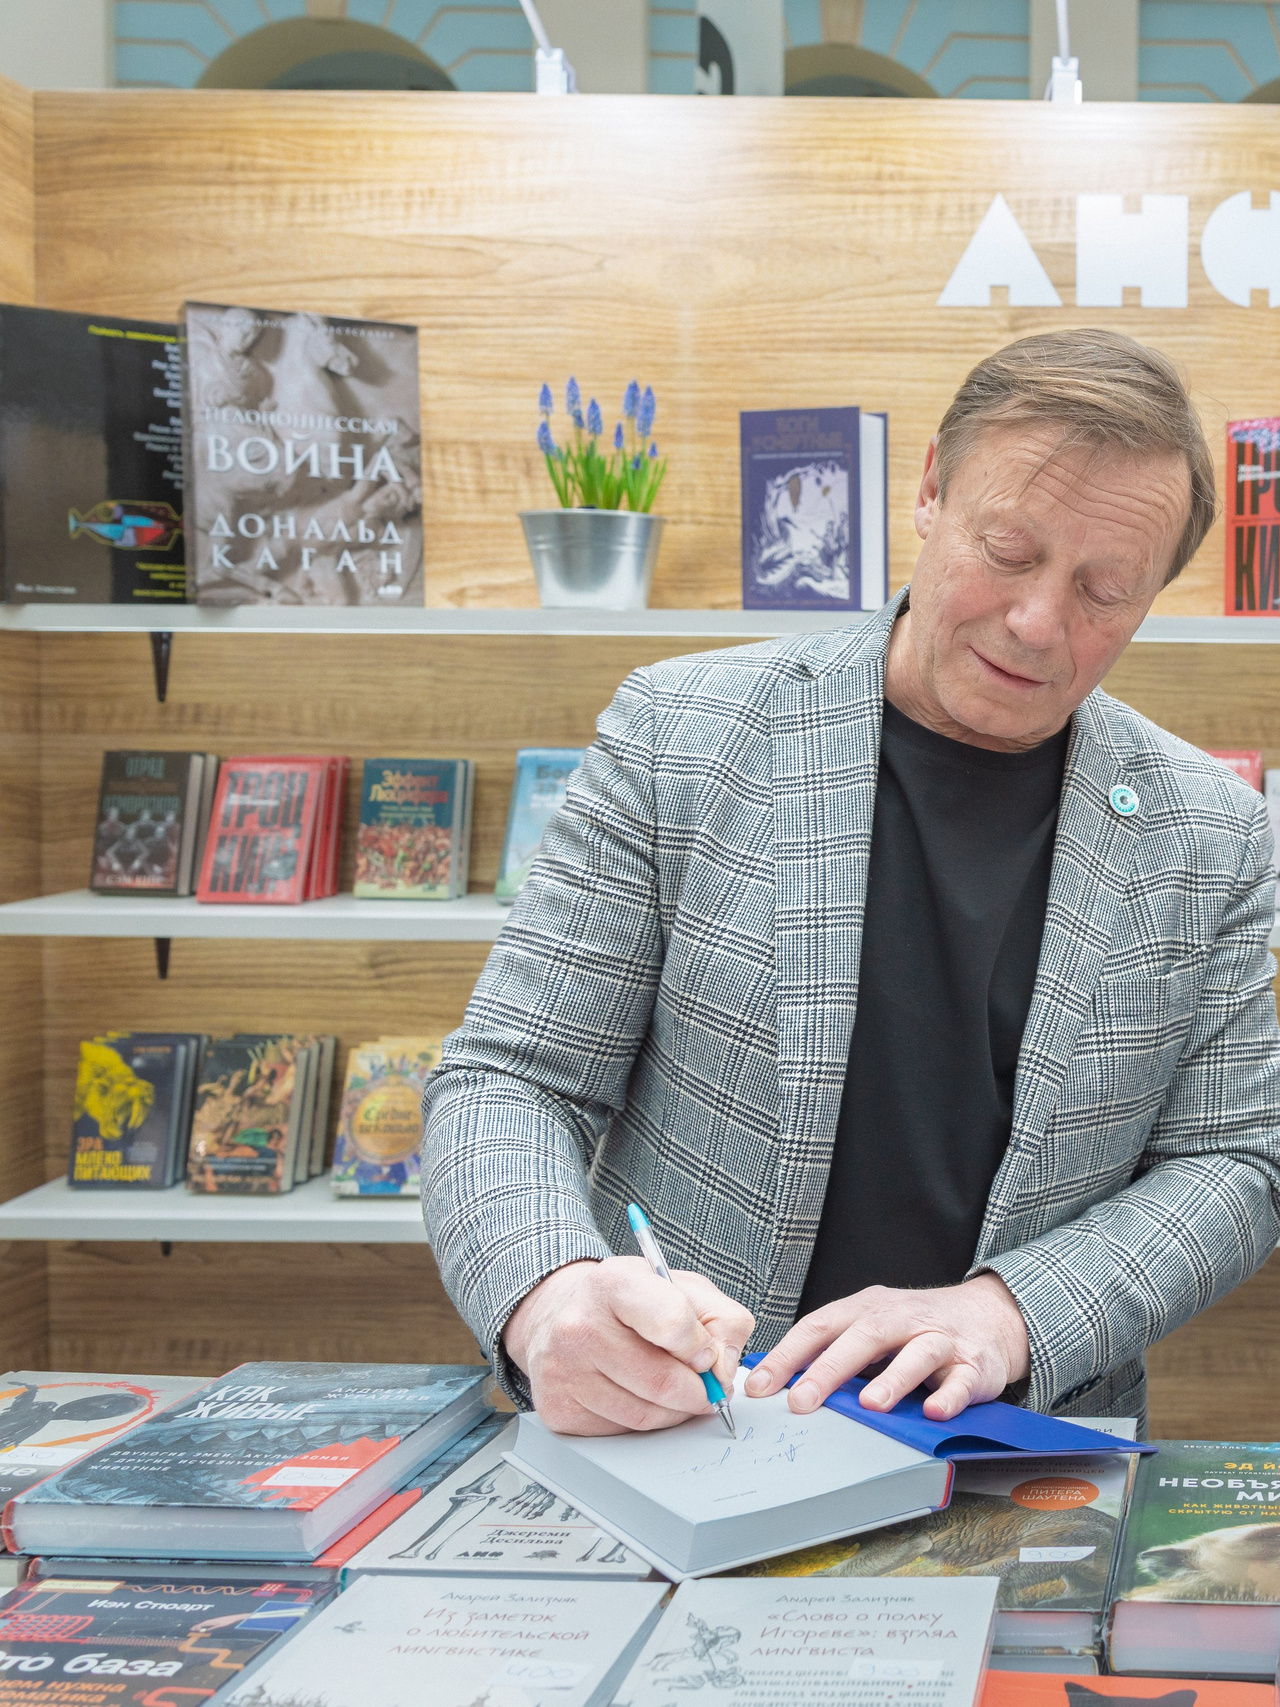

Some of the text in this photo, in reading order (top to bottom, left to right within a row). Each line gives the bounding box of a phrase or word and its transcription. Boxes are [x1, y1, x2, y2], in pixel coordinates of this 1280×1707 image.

[206, 432, 402, 484] ВОЙНА
[209, 512, 404, 545] ДОНАЛЬД
[211, 545, 402, 575] КАГАН
[204, 1385, 287, 1402] КАК
[174, 1401, 327, 1421] ЖИВЫЕ
[192, 1451, 234, 1459] ЗМЕИ,
[179, 1459, 283, 1467] ИСЧЕЗНУВШИЕ
[1224, 1462, 1254, 1471] ЭД
[1021, 1494, 1087, 1502] ШАУТЕНА
[1168, 1508, 1233, 1516] СКРЫТУЮ
[479, 1536, 564, 1545] Десильва
[487, 1529, 572, 1538] Джереми
[87, 1598, 215, 1613] Иэн Стюарт
[422, 1607, 458, 1625] Из
[63, 1652, 184, 1678] база
